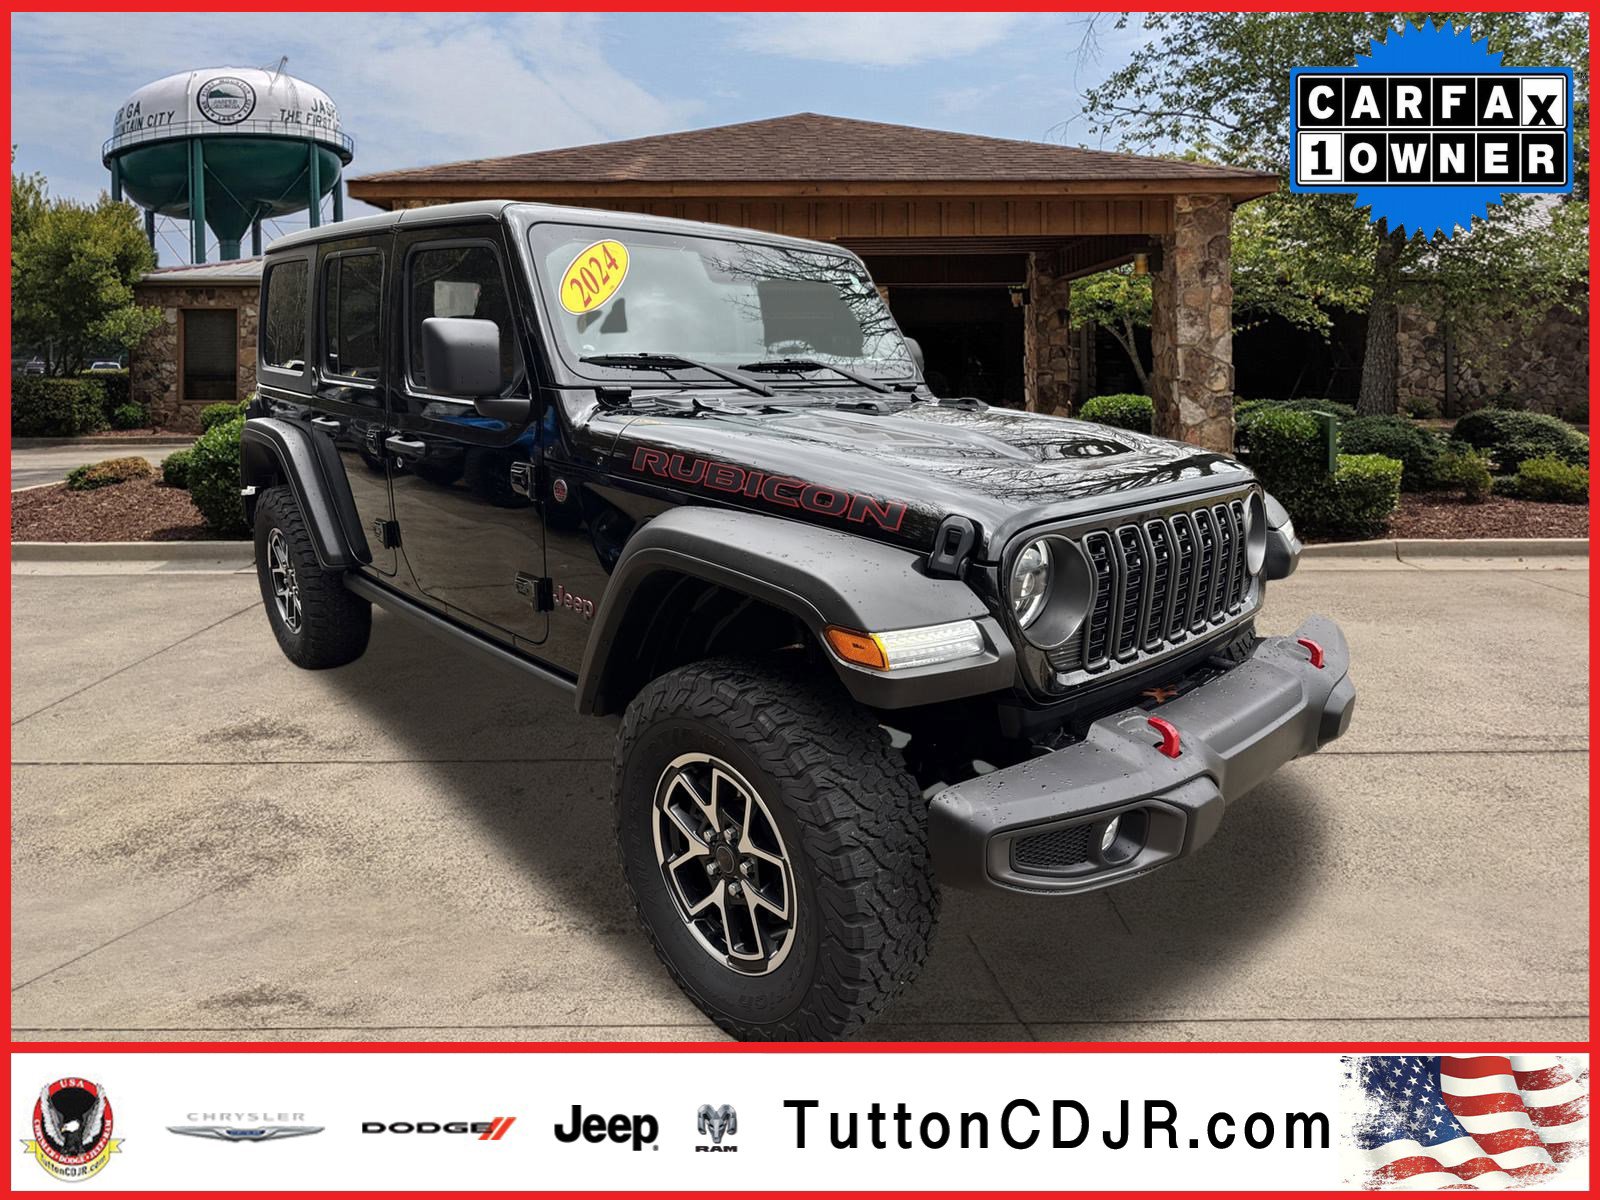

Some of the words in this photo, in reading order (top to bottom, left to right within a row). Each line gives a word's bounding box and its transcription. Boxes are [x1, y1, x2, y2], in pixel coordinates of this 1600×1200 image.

[126, 100, 141, 119] GA
[147, 110, 175, 127] CITY
[280, 108, 302, 123] THE
[570, 244, 619, 308] 2024
[632, 446, 908, 531] RUBICON
[553, 585, 595, 621] Jeep
